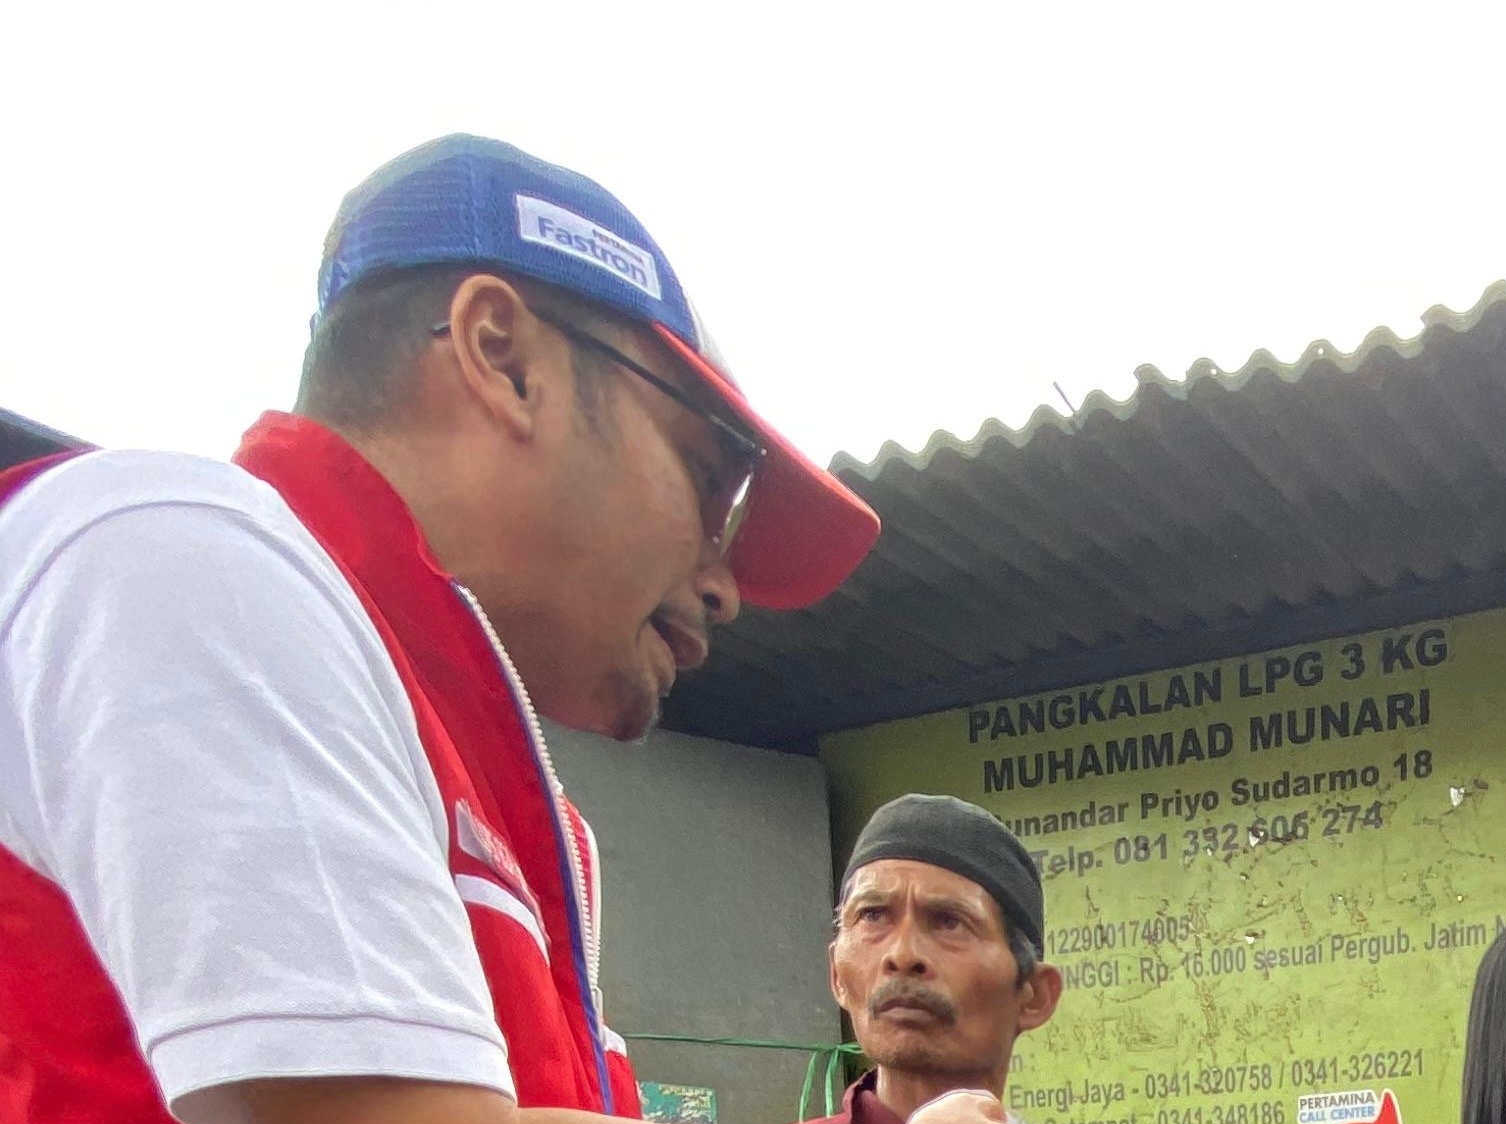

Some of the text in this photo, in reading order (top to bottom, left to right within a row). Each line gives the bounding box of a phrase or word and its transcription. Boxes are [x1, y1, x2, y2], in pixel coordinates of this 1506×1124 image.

[538, 215, 648, 288] Fastron
[969, 629, 1448, 744] PANGKALAN LPG 3 KG
[984, 688, 1430, 794] MUHAMMAD MUNARI
[996, 750, 1433, 837] unandar Priyo Sudarmo 18
[1031, 845, 1103, 878] Telp.
[1114, 832, 1168, 865] 081
[1183, 823, 1239, 857] 332
[1323, 800, 1384, 837] 274
[1060, 959, 1120, 990] INGGI
[1254, 942, 1323, 971] sesuai
[1331, 931, 1417, 964] Pergub.
[1424, 920, 1487, 952] Jatim
[1009, 1081, 1073, 1113] Energi
[1080, 1079, 1126, 1109] Jaya
[1145, 1063, 1272, 1100] 0341-320758
[1292, 1048, 1424, 1088] 0341-326221
[1299, 1092, 1376, 1111] PERTAMINA
[1299, 1105, 1376, 1124] CALL CENTER
